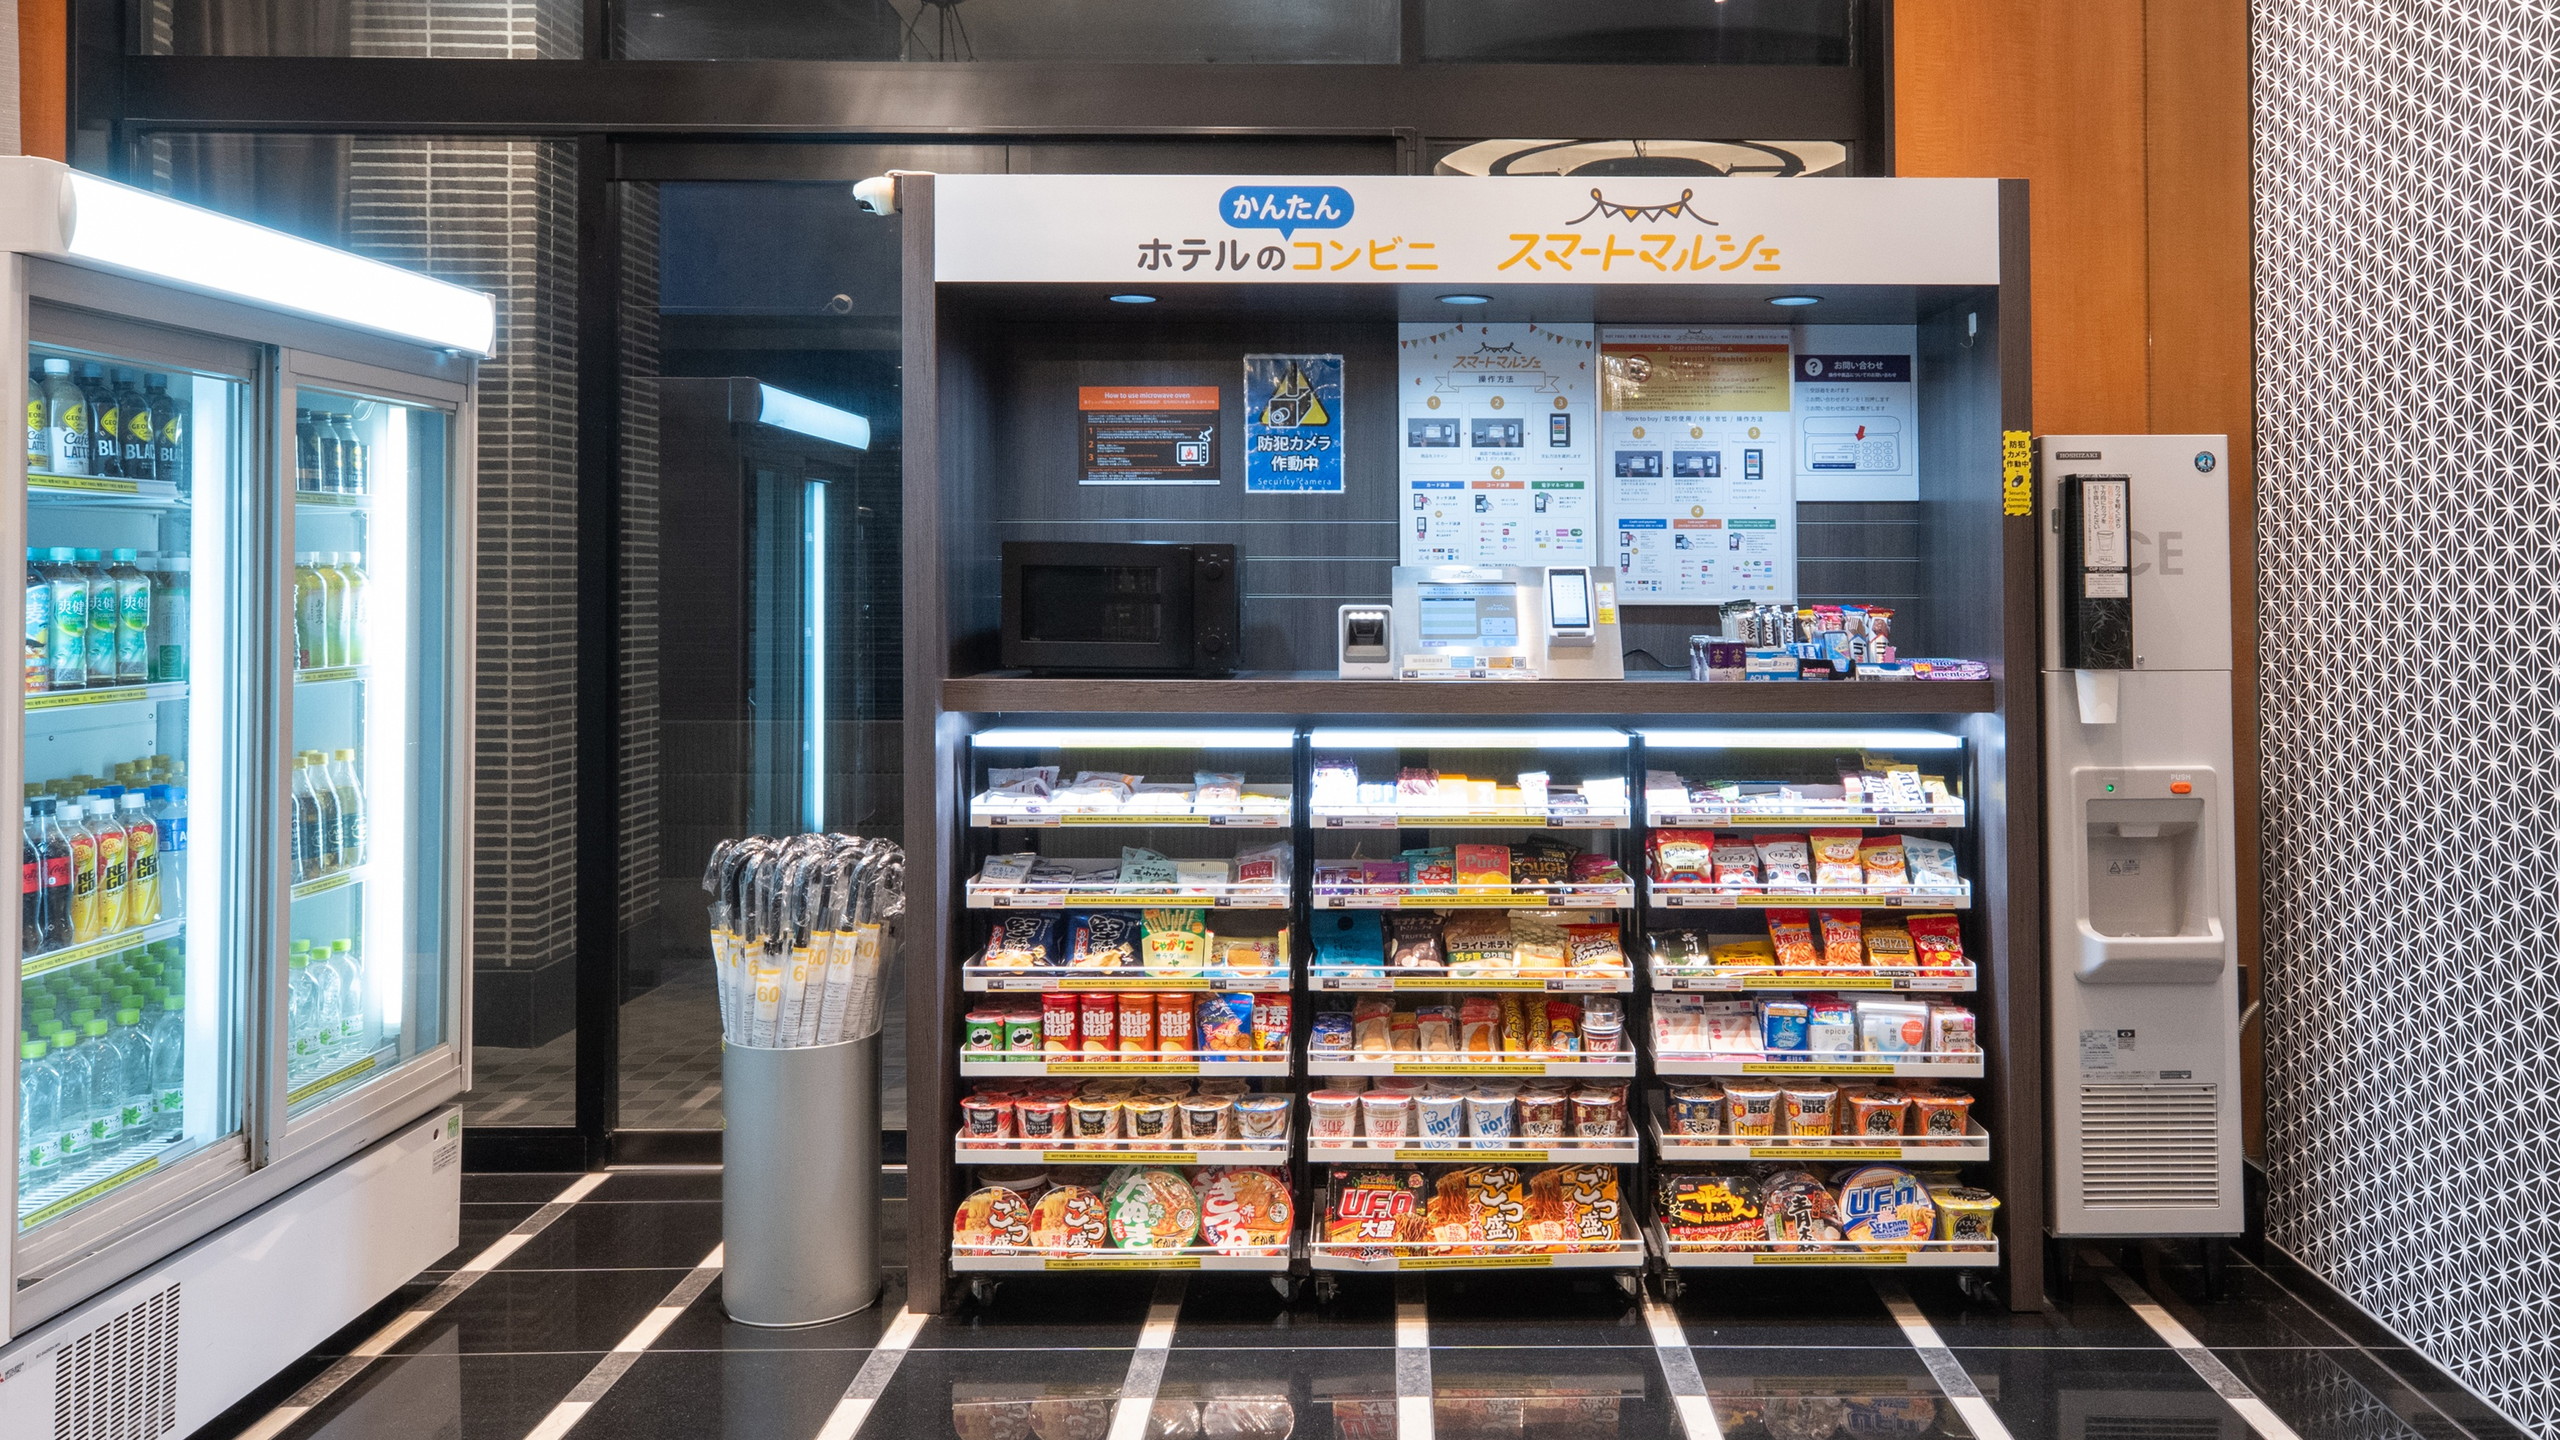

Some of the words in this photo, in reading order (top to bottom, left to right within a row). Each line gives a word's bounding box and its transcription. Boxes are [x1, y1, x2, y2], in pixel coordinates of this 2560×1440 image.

[1232, 194, 1341, 220] かんたん
[1138, 236, 1439, 272] ホテルのコンビニ
[1498, 234, 1780, 272] スマートマルシェ
[1453, 356, 1541, 369] スマートマルシェ
[1834, 361, 1883, 370] お問い合わせ
[1258, 436, 1331, 451] 防犯カメラ
[2009, 440, 2025, 449] 防犯
[64, 446, 89, 459] LATT
[2007, 450, 2028, 459] カメラ
[1271, 455, 1319, 471] 作動中
[2007, 460, 2029, 468] 作動中
[1258, 478, 1296, 487] Security
[2131, 531, 2183, 576] CE
[1465, 854, 1500, 868] Puré
[1152, 939, 1194, 951] じゃがりこ
[1868, 937, 1913, 949] PRETZEL
[833, 949, 851, 965] 60
[757, 986, 780, 1003] 60
[1589, 1041, 1616, 1051] UCC
[1427, 1117, 1451, 1135] HOT
[1480, 1116, 1503, 1135] HOT
[1529, 1123, 1559, 1135] 鴨だし
[1584, 1123, 1615, 1136] 鴨だし
[1685, 1121, 1717, 1132] 天ぷら
[1677, 1184, 1758, 1218] 一平ちゃん
[1116, 1173, 1156, 1255] たぬき
[1203, 1178, 1250, 1255] きつね
[1358, 1220, 1395, 1238] 大盛
